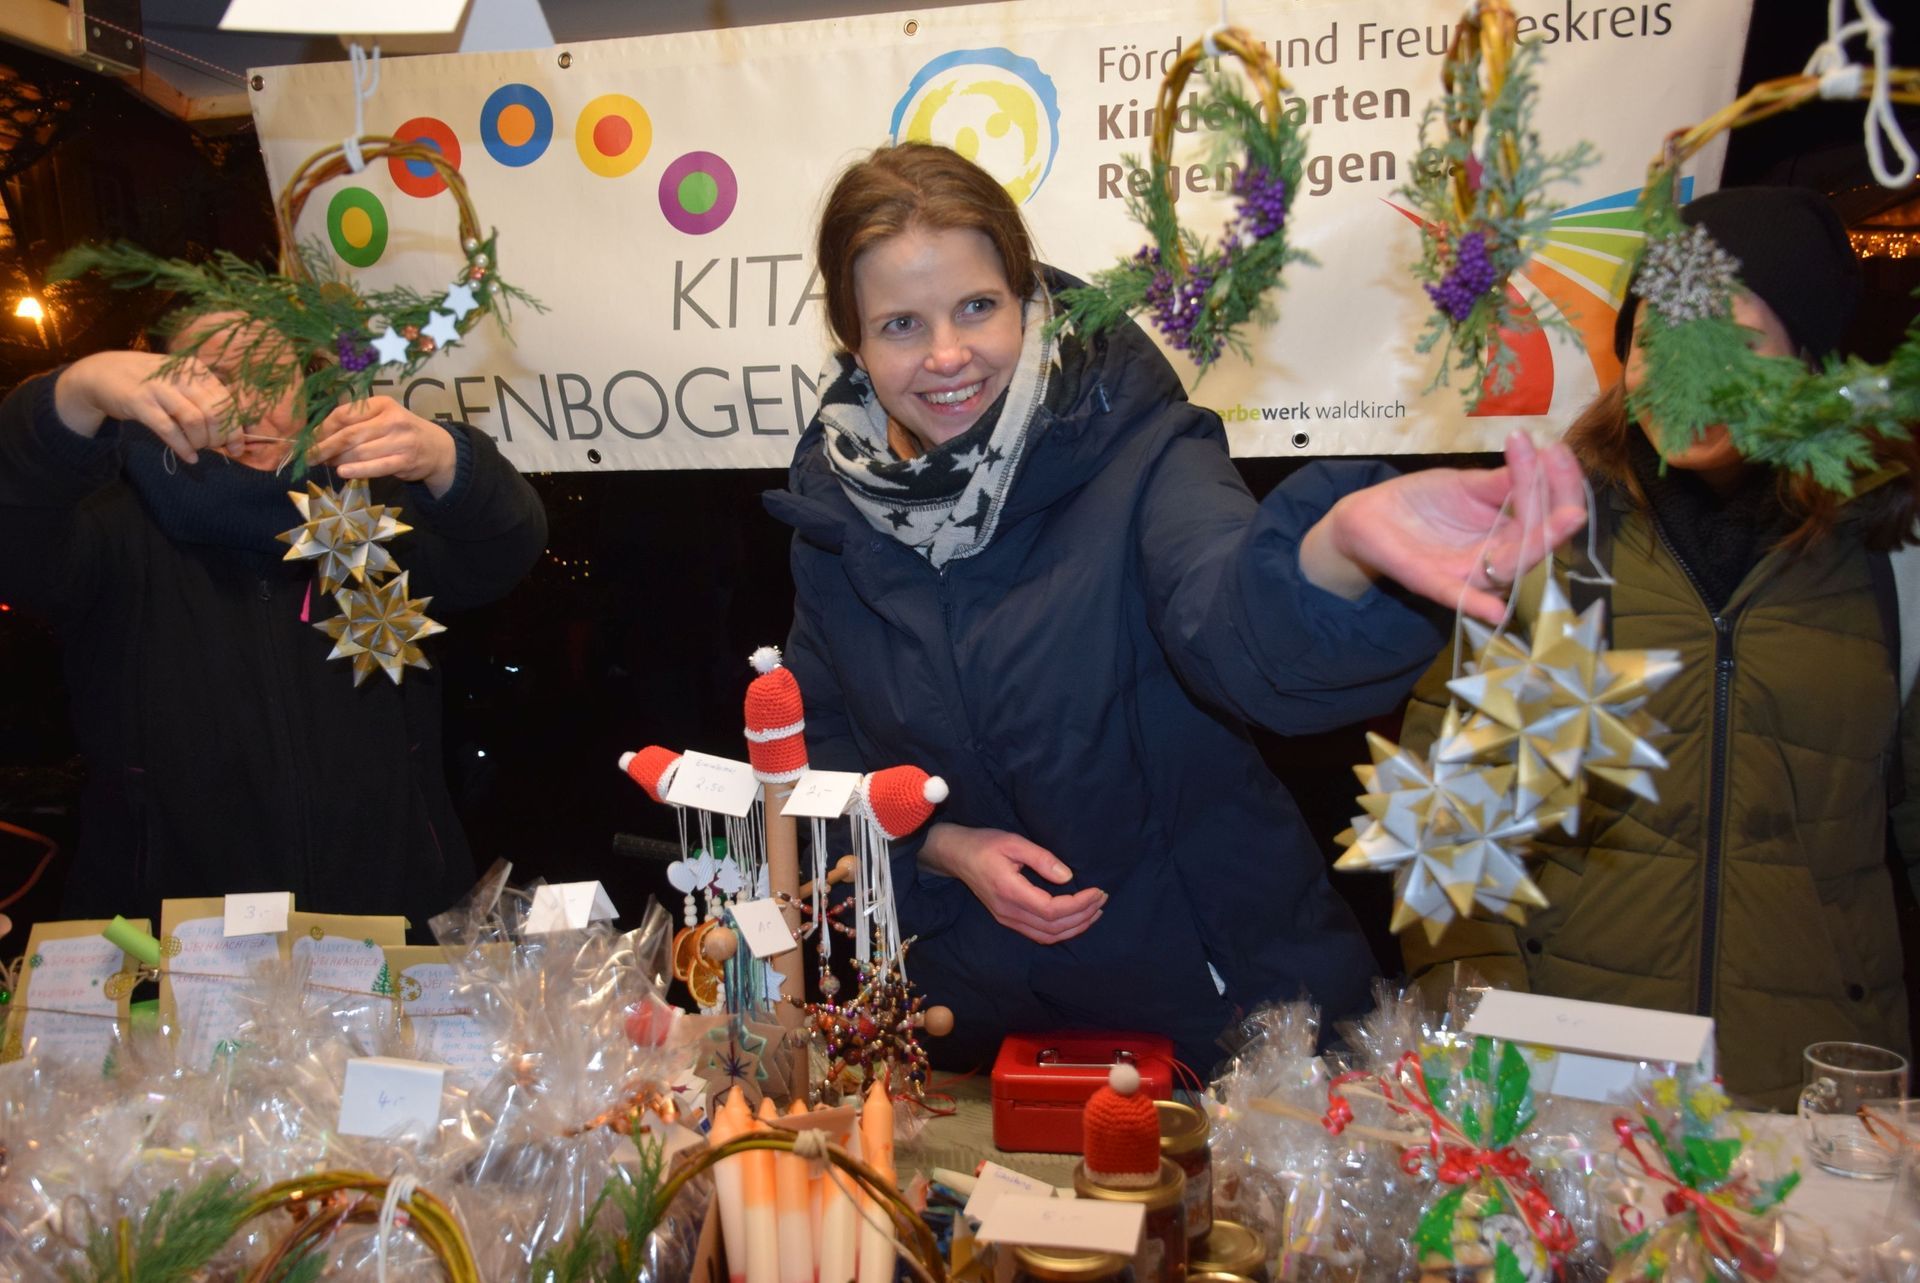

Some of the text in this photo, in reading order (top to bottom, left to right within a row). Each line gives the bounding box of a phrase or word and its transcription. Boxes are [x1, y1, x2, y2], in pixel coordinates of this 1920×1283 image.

[1358, 0, 1673, 60] Freueskreis
[1099, 86, 1410, 140] Kindearten
[1099, 150, 1396, 204] Reengen
[673, 253, 826, 330] KITA
[335, 363, 818, 443] GENBOGEN
[1217, 400, 1406, 421] erbewerk waldkirch
